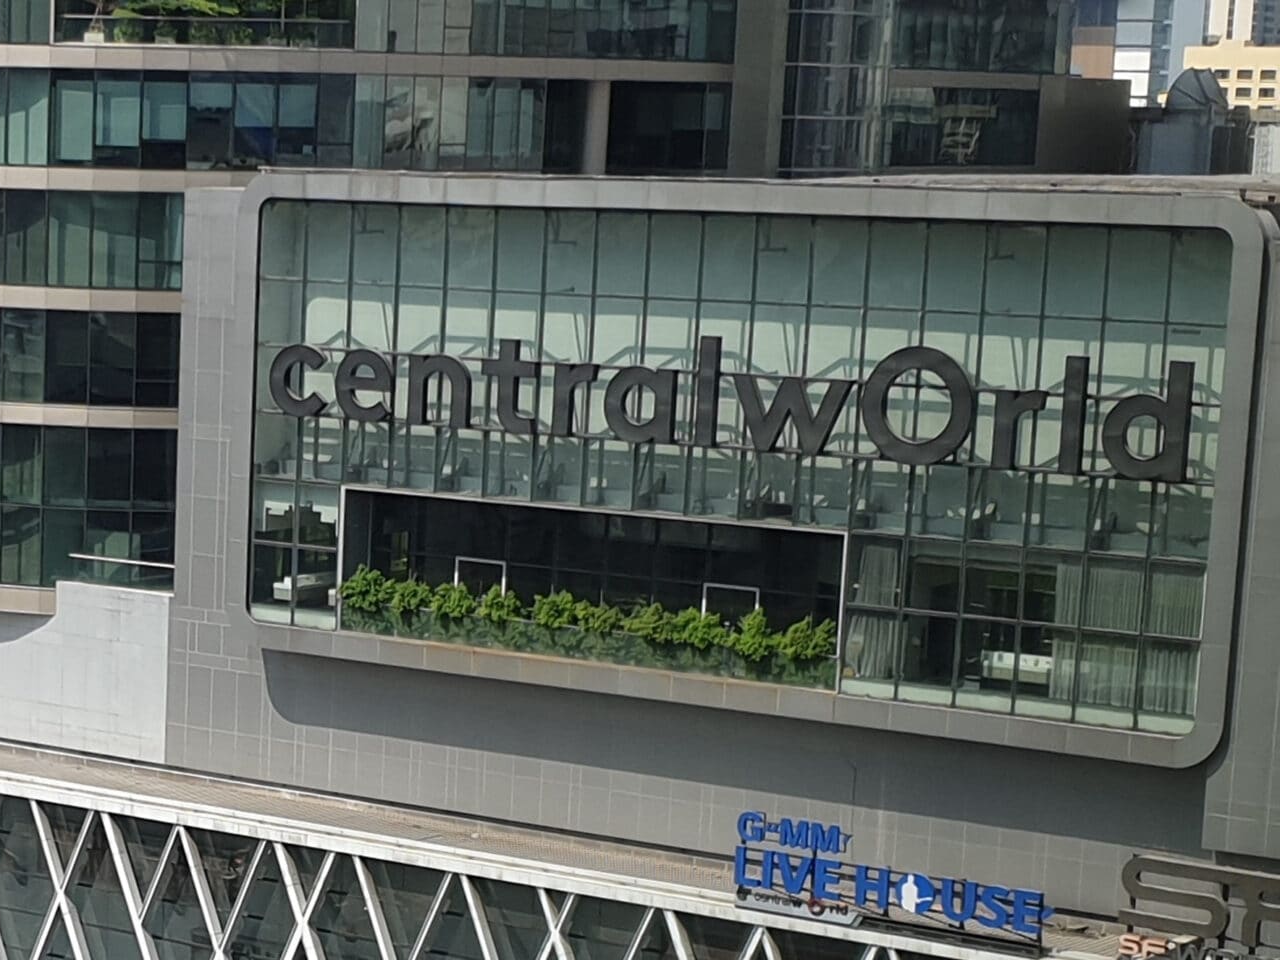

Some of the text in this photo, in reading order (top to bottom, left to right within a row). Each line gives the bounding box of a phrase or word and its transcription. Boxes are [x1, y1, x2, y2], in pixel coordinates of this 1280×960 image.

[269, 336, 1195, 482] centralwOrld
[734, 844, 1045, 935] LIVE HOUSE
[1118, 934, 1169, 959] SF
